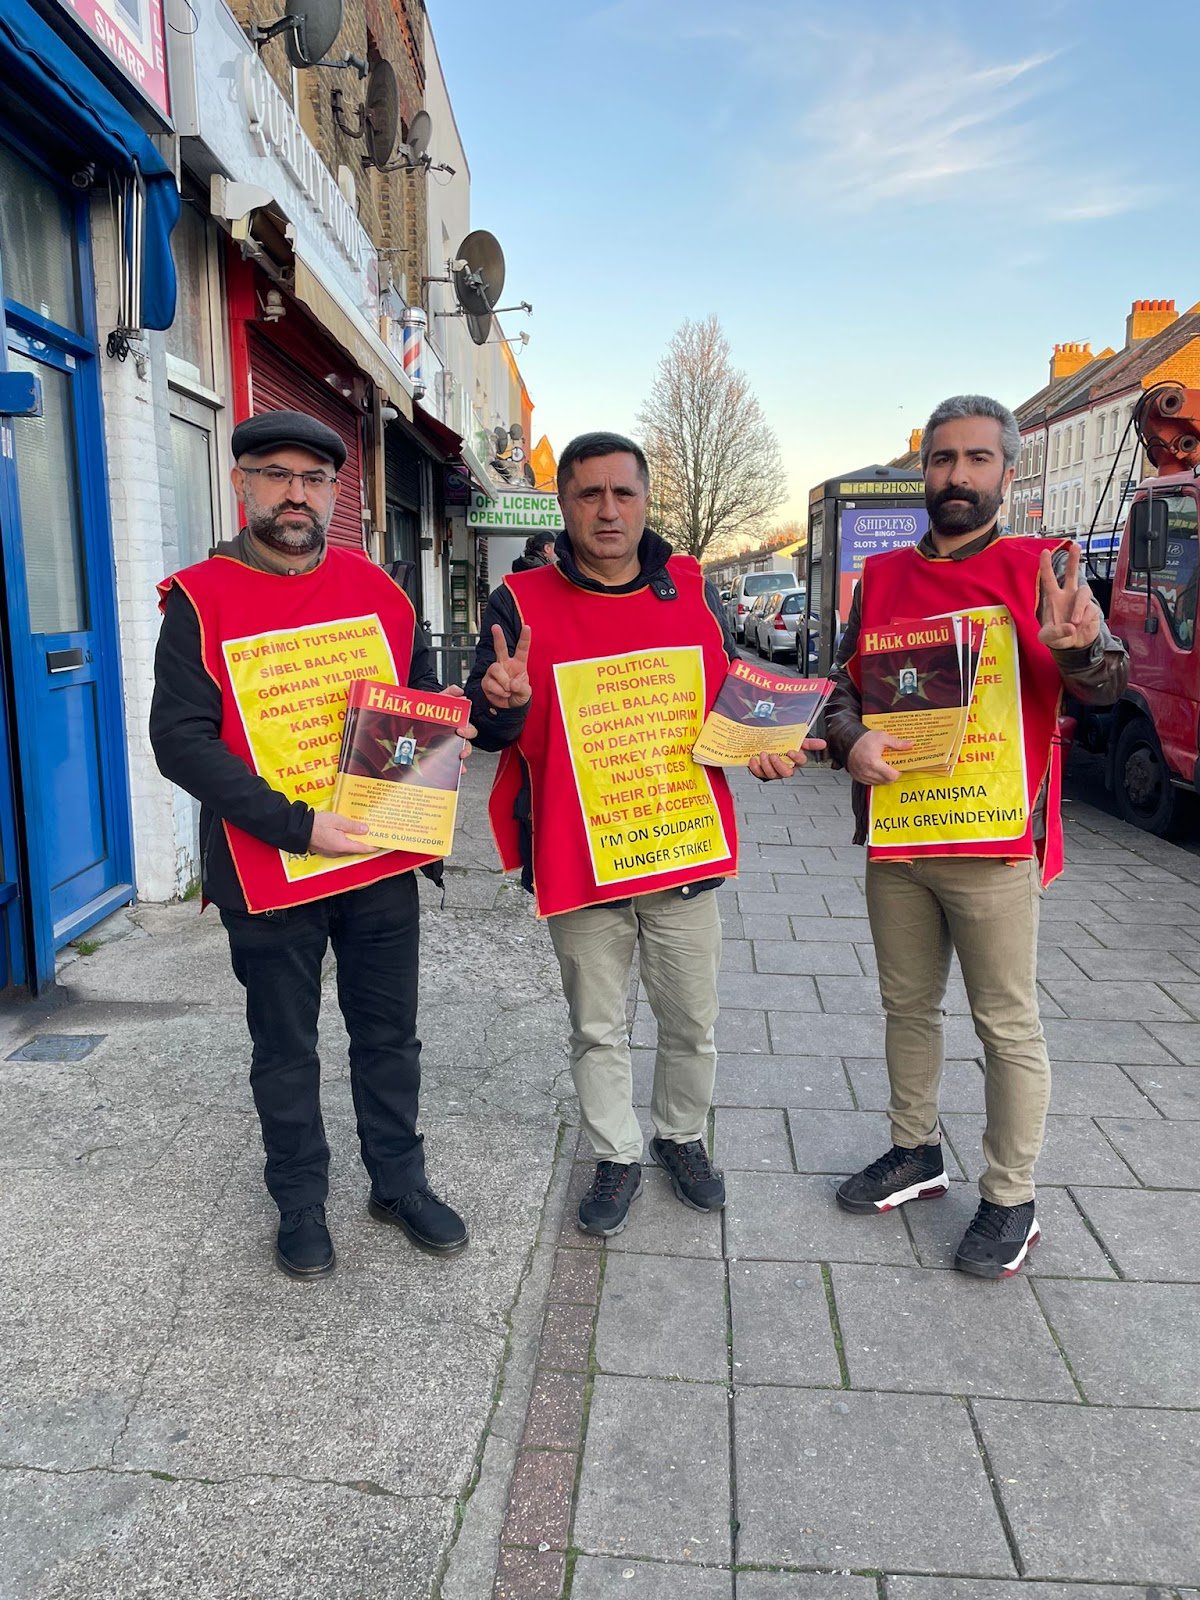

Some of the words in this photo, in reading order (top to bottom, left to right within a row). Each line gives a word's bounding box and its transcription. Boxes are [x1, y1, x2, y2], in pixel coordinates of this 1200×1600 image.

[94, 9, 145, 83] SHARP
[246, 53, 324, 213] QUALITY
[851, 482, 924, 493] TELEPHONE
[476, 496, 498, 508] OFF
[503, 497, 556, 511] LICENCE
[857, 518, 914, 532] SHIPLEYS
[893, 540, 917, 548] SLOTS
[231, 639, 300, 663] DEVRİMCİ
[303, 626, 378, 648] TUTSAKLAR
[865, 633, 904, 652] HALK
[260, 662, 301, 679] SİBEL
[304, 652, 348, 669] BALAÇ
[350, 648, 368, 660] VE
[596, 657, 670, 677] POLITICAL
[258, 677, 320, 699] GÖKHAN
[323, 665, 379, 685] YILDIRIM
[596, 673, 676, 695] PRISONERS
[735, 664, 772, 689] HALK
[975, 674, 1002, 686] ERE
[259, 690, 349, 720] ADALETSİZLİ
[367, 687, 412, 714] HALK
[622, 692, 670, 709] BALAÇ
[672, 691, 696, 703] AND
[290, 714, 334, 733] KARŞI
[337, 709, 346, 721] Ö
[581, 714, 645, 736] GÖKHAN
[647, 709, 698, 723] YILDIRIM
[583, 740, 605, 754] ON
[608, 730, 657, 748] DEATH
[660, 727, 689, 742] FAST
[690, 726, 698, 737] IN
[963, 732, 1006, 745] ERHAL
[275, 755, 339, 779] TALEPLE
[589, 749, 648, 770] TURKEY
[958, 751, 994, 763] LSİN!
[294, 775, 337, 795] KABU
[600, 790, 645, 806] THEIR
[647, 779, 698, 797] DEMANDS
[900, 785, 987, 804] DAYANIŞMA
[590, 808, 631, 827] MUST
[633, 804, 652, 818] BE
[656, 793, 713, 814] ACCEPTED!
[874, 816, 910, 832] AÇLIK
[913, 806, 1024, 827] GREVİNDEYİM!
[627, 828, 649, 843] ON
[653, 815, 715, 838] SOLIDARITY
[614, 848, 670, 871] HUNGER
[673, 839, 713, 859] STRIKE!
